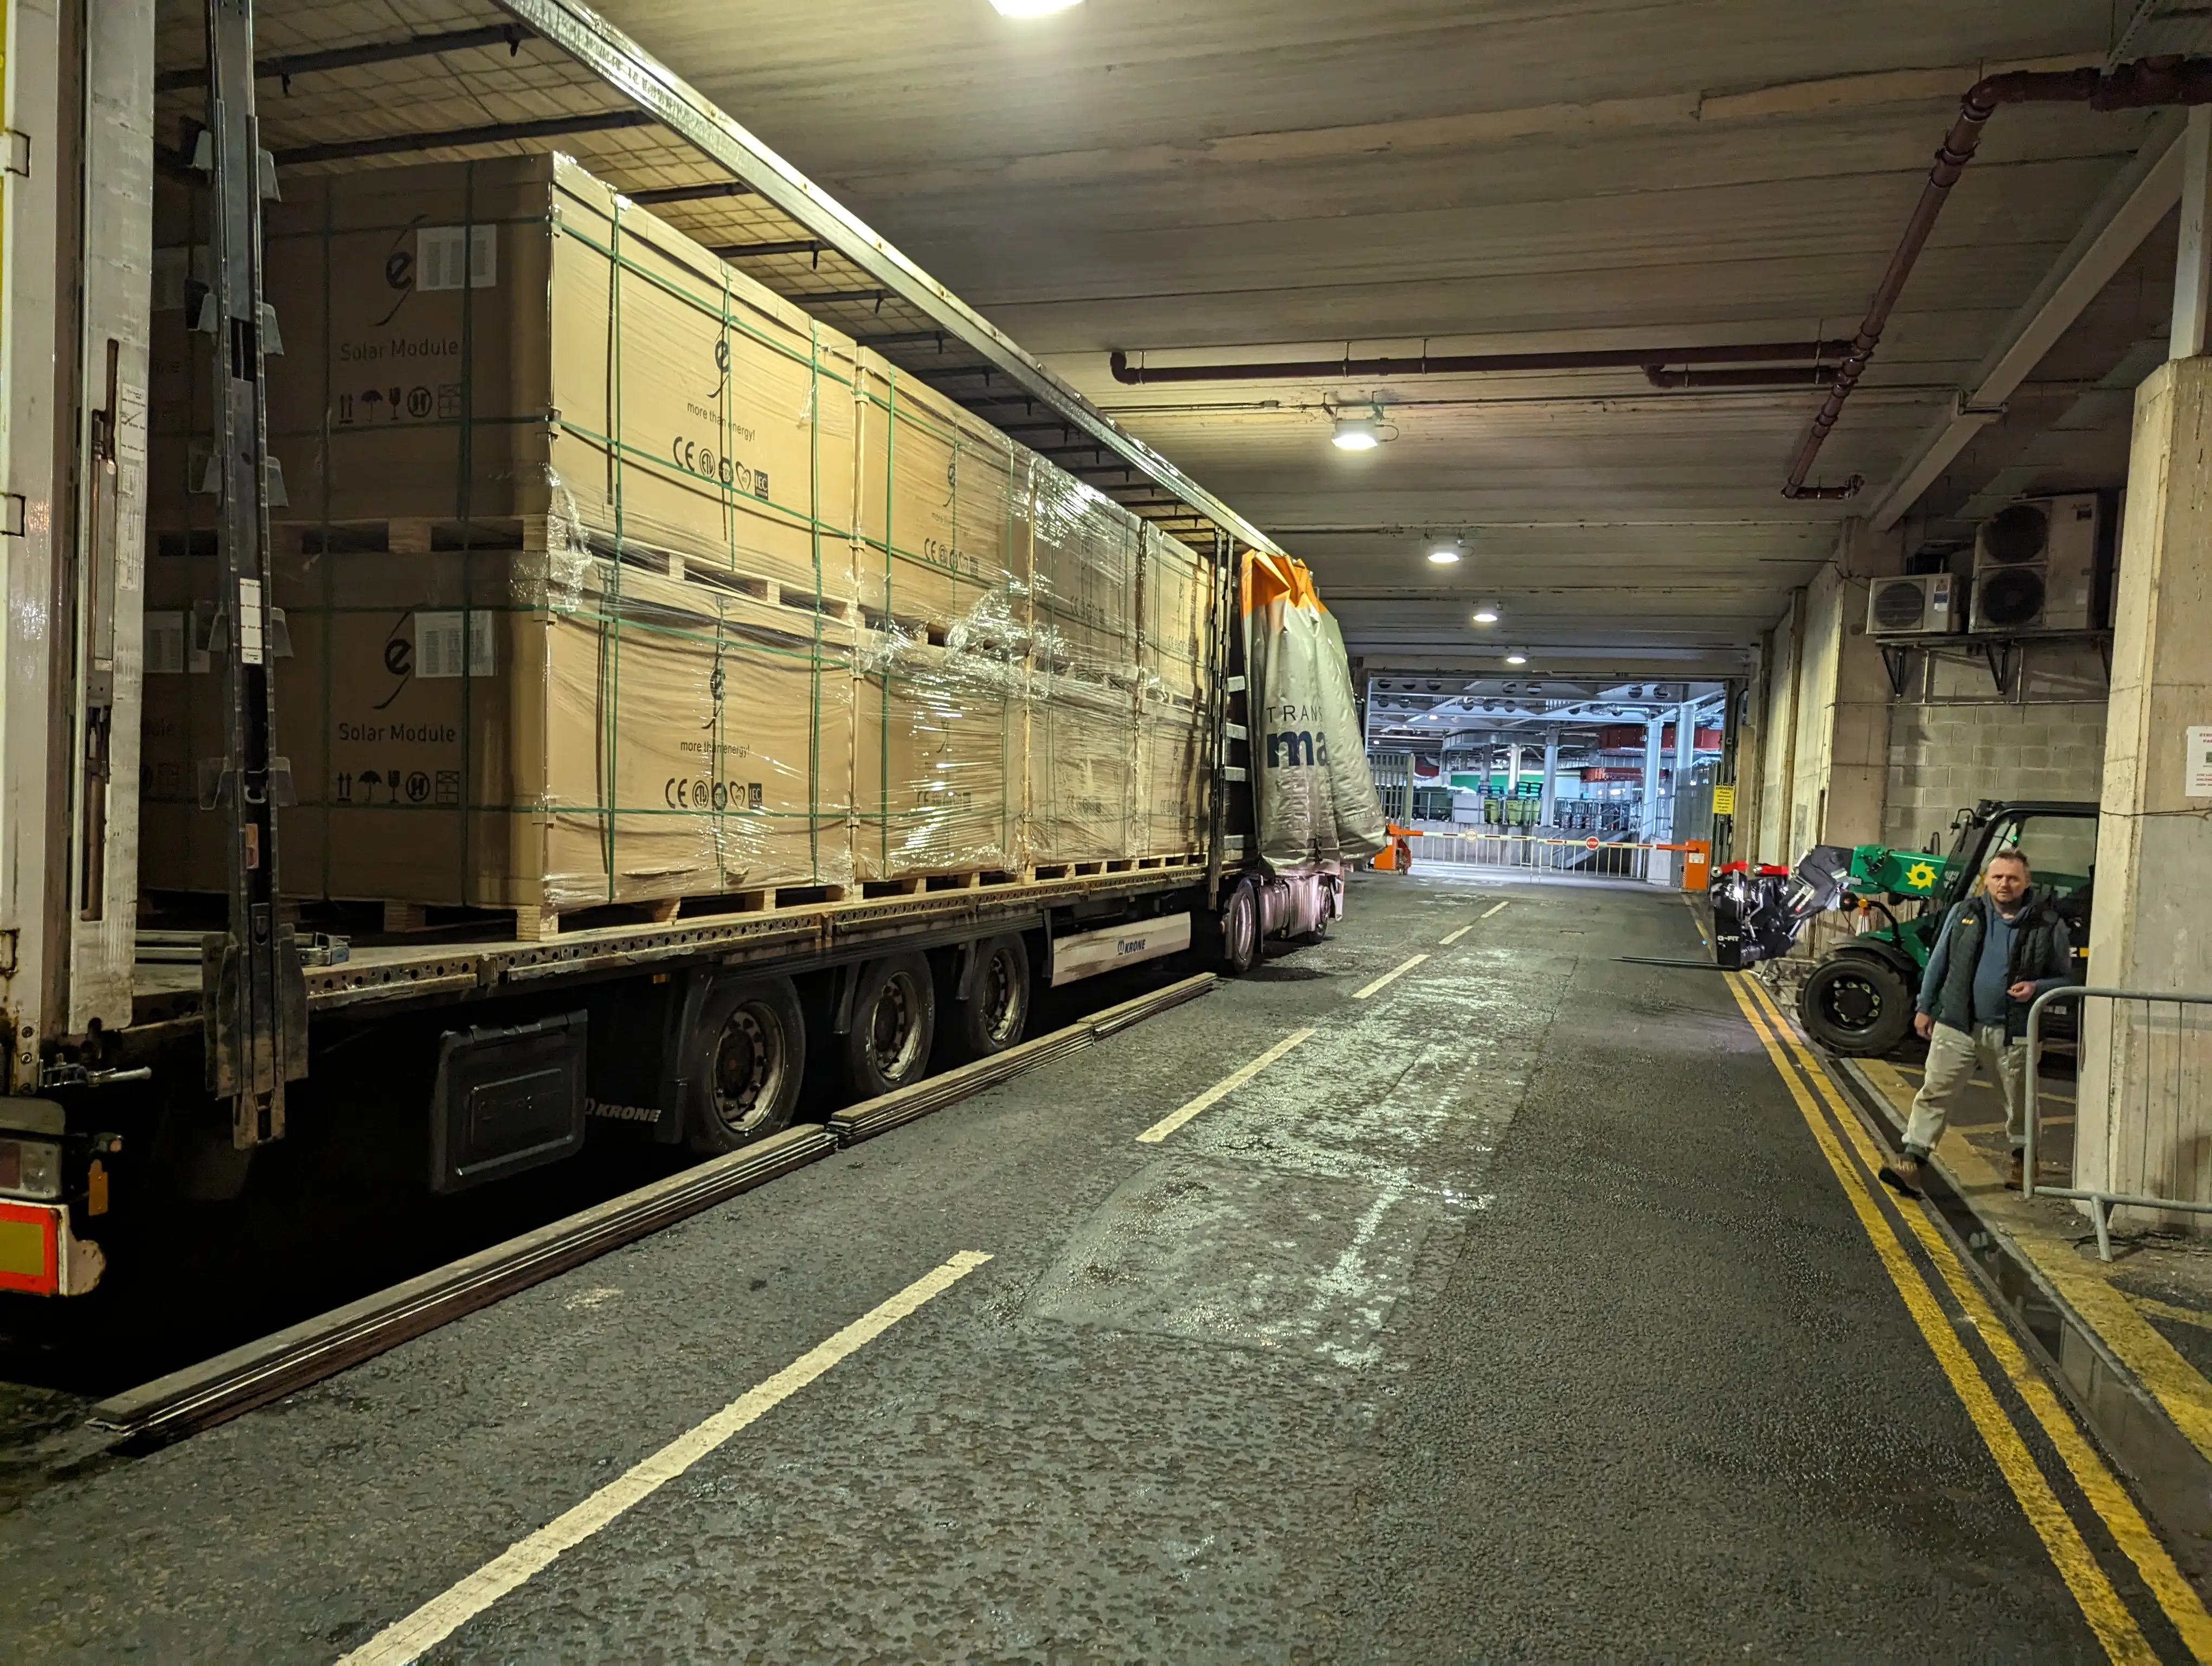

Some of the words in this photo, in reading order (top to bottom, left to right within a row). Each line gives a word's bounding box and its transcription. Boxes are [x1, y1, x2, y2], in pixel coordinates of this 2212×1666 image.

[340, 342, 384, 361] Solar
[391, 338, 459, 357] Module
[687, 402, 708, 420] more
[709, 410, 726, 428] than
[673, 436, 695, 472] CE
[755, 475, 768, 491] IEC
[1266, 705, 1323, 723] TRANS
[339, 722, 385, 741] Solar
[390, 723, 456, 742] Module
[680, 741, 702, 752] more
[704, 741, 722, 753] than
[724, 745, 750, 758] energy!
[665, 778, 687, 809] CE
[749, 788, 762, 801] IEC
[1124, 939, 1146, 954] KRONE
[595, 1103, 661, 1123] KRONE
